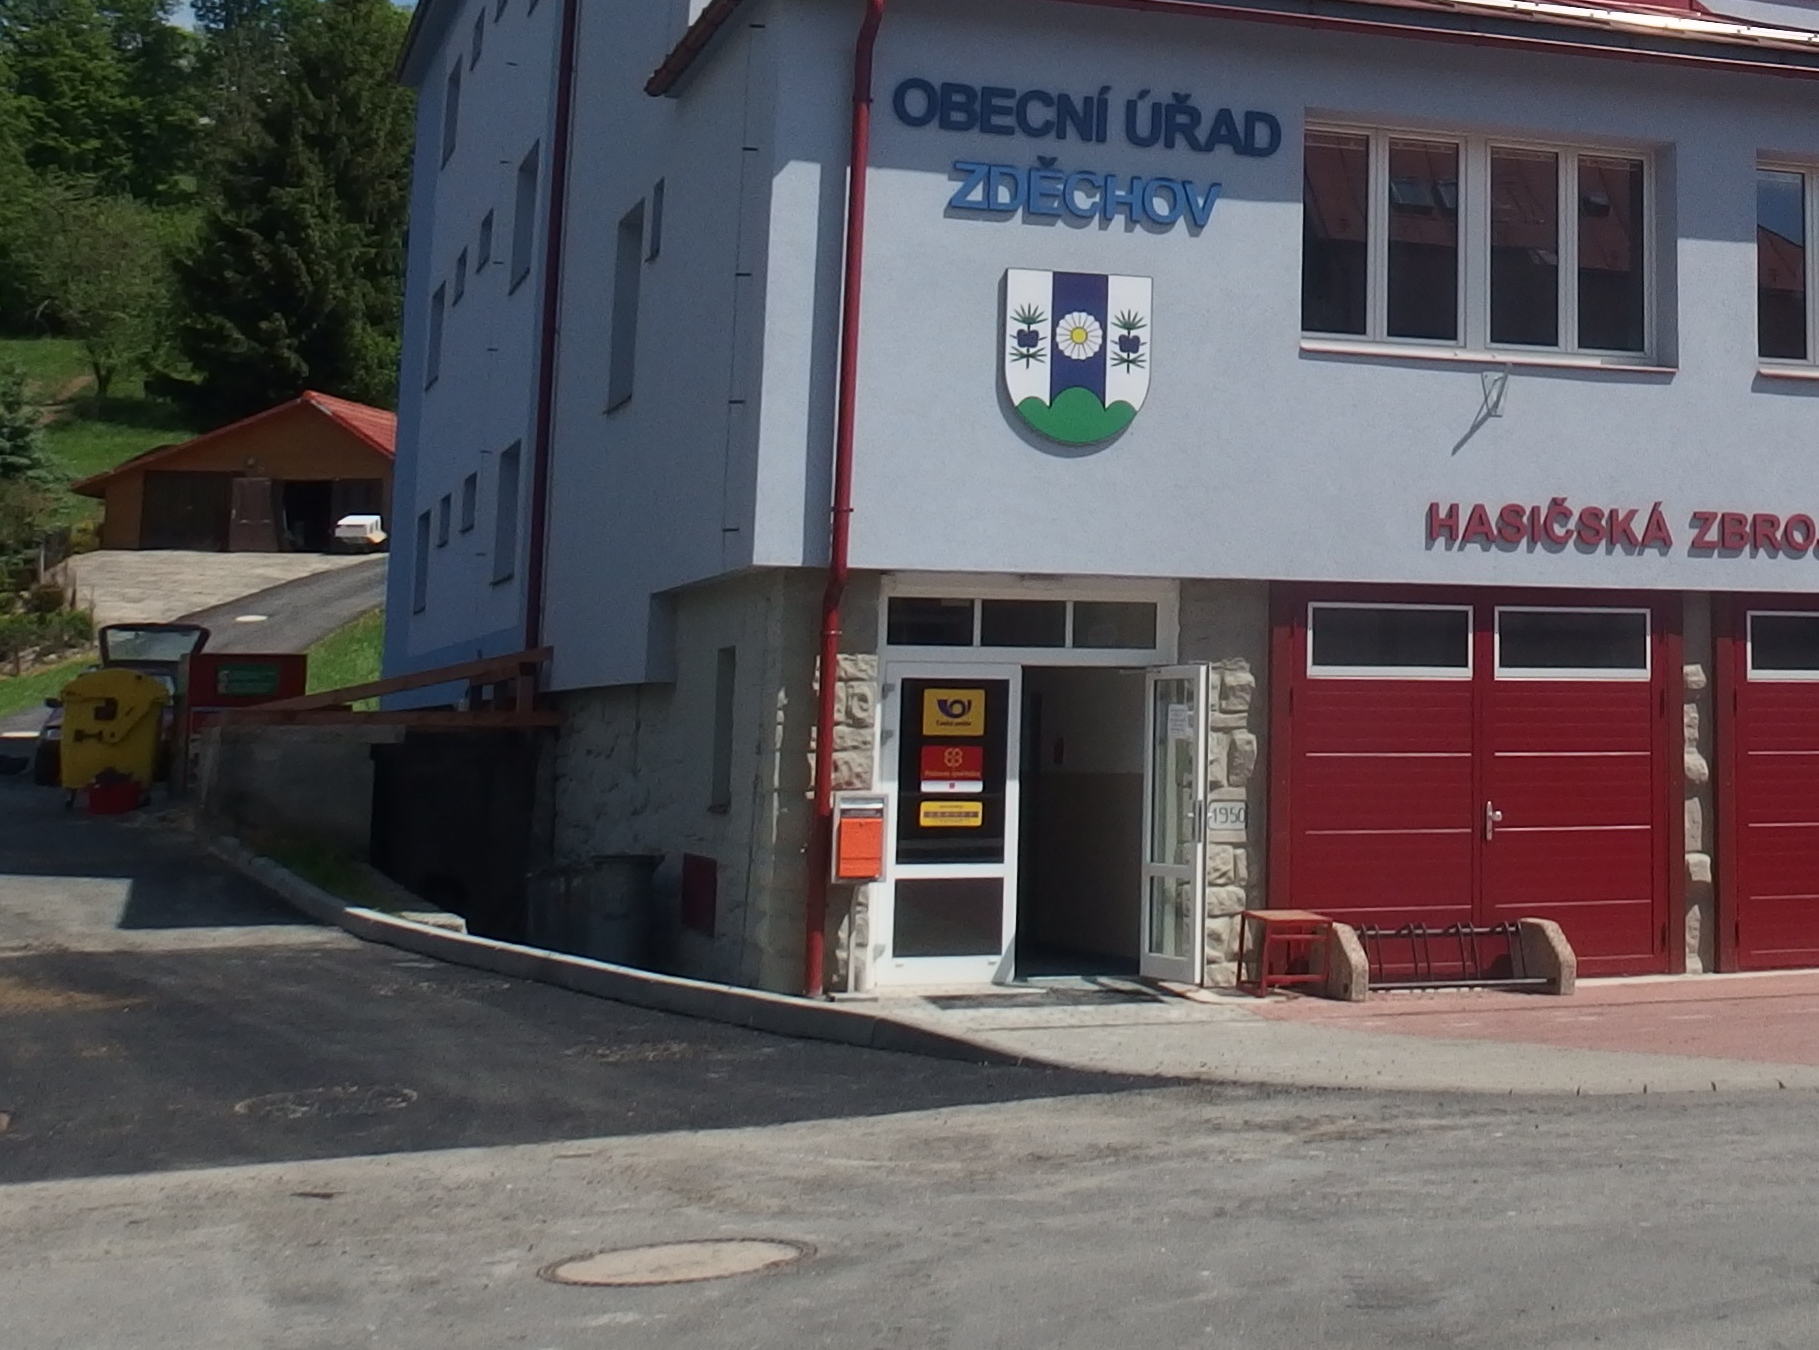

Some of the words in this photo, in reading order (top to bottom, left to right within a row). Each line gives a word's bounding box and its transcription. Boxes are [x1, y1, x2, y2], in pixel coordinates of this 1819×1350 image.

[892, 77, 1110, 143] OBECNÍ
[1125, 88, 1282, 157] ÚŘAD
[948, 156, 1222, 227] ZDĚCHOV
[1428, 497, 1673, 549] HASIČSKÁ
[1212, 806, 1246, 824] 1950
